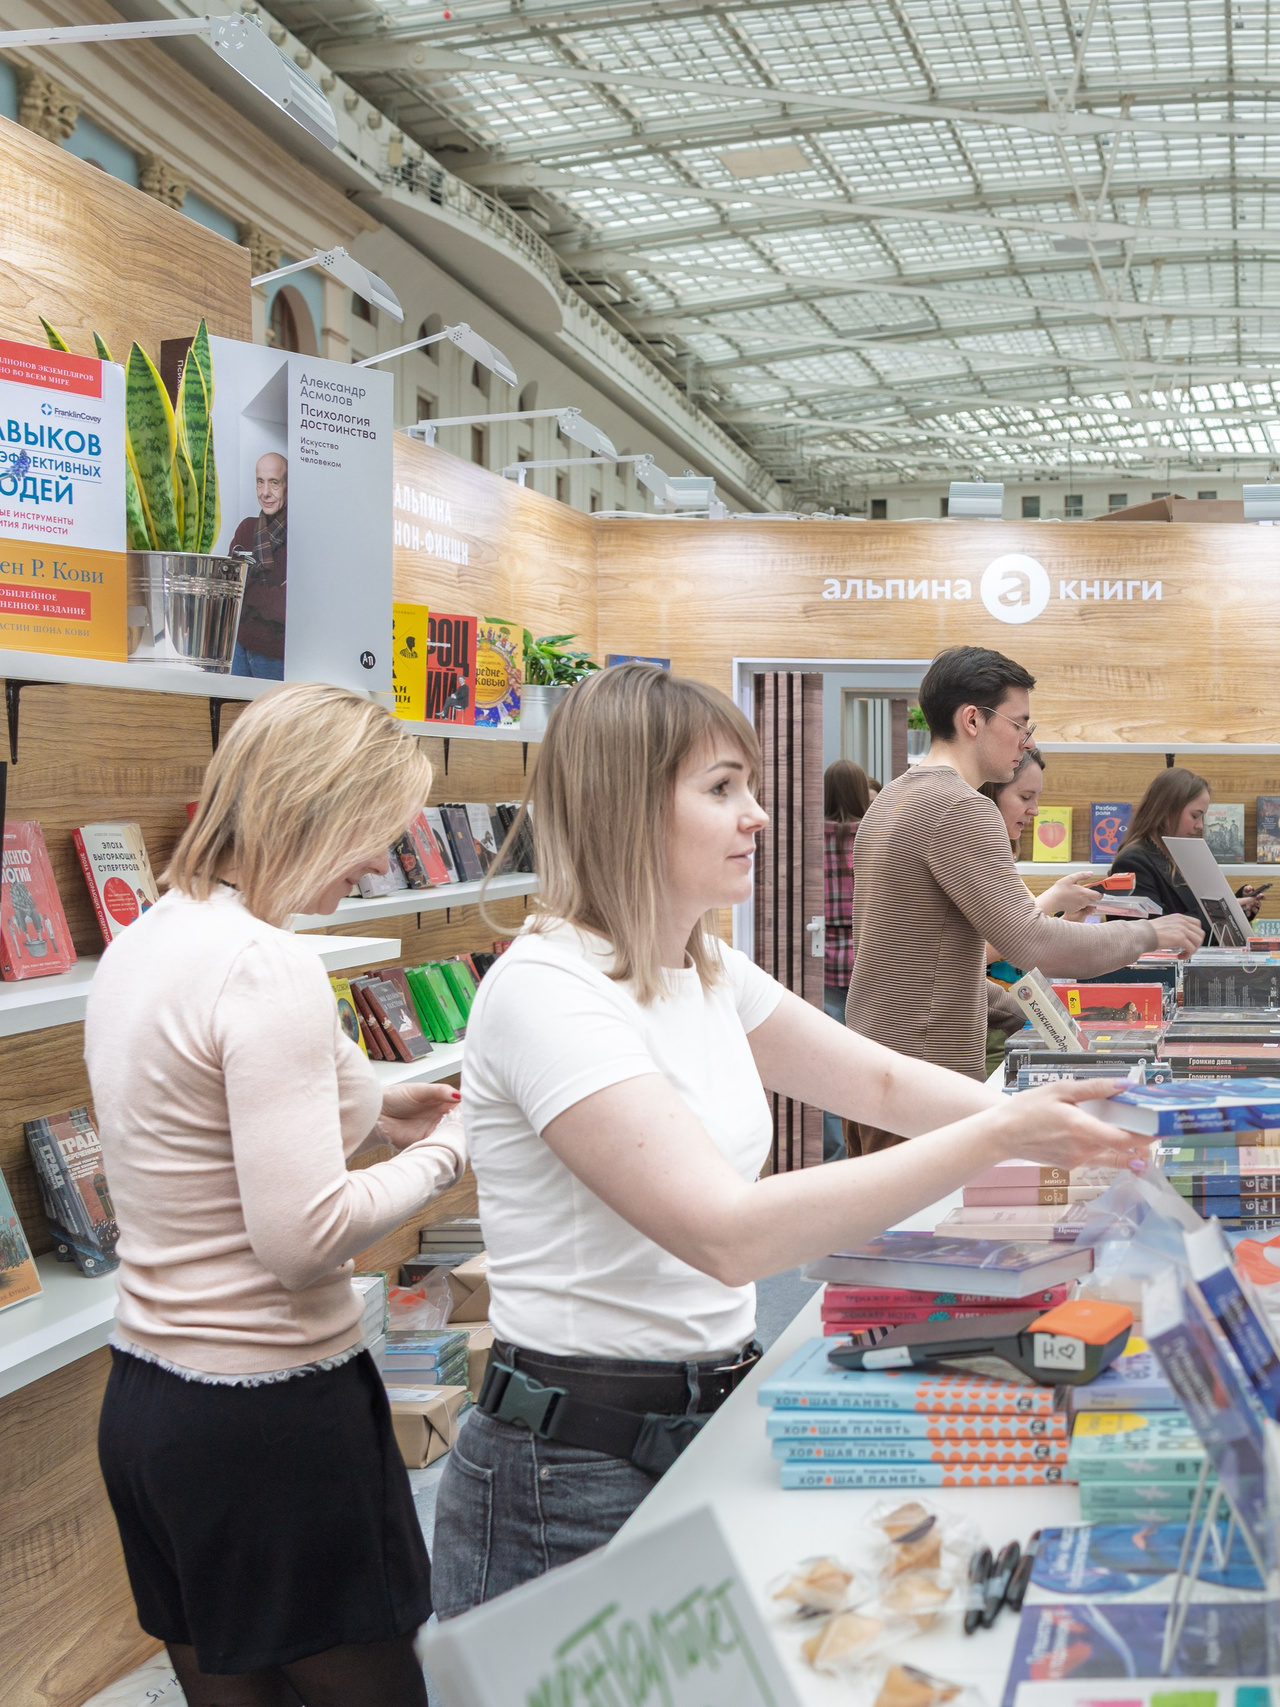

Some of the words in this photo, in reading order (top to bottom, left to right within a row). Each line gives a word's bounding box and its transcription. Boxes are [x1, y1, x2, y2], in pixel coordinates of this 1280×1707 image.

[0, 357, 37, 370] ЛИОНОВ
[38, 365, 94, 381] ЭКЗЕМПЛЯРОВ
[12, 369, 24, 377] ВО
[25, 371, 47, 381] ВСЕМ
[48, 376, 70, 386] МИРЕ
[300, 374, 366, 399] Александр
[300, 386, 353, 406] Асмолов
[54, 407, 102, 424] FranklinCovey
[301, 403, 370, 427] Психология
[300, 419, 377, 440] достоинства
[300, 437, 339, 450] Искусство
[300, 446, 319, 456] быть
[300, 457, 341, 468] человеком
[394, 482, 452, 525] АЛЬПИНА
[13, 511, 74, 526] ИНСТРУМЕНТЫ
[21, 522, 69, 535] ЛИЧНОСТИ
[394, 520, 469, 566] НОН-ФИКШН
[31, 558, 45, 578] Р.
[53, 560, 104, 584] Кови
[822, 578, 972, 601] альпина
[1059, 580, 1163, 601] книги
[42, 605, 87, 616] ИЗДАНИЕ
[33, 624, 62, 634] ШОНА
[65, 628, 90, 637] КОВИ
[101, 841, 124, 849] ЭПОХА
[92, 853, 137, 861] ВЫГОРАЮЩИХ
[97, 864, 140, 872] СУПЕРГЕРОЕВ
[80, 852, 90, 871] ЭПОХА
[86, 872, 102, 910] ВЫГОРАЮЩИХ
[1188, 1057, 1215, 1065] Громкие
[1216, 1058, 1232, 1066] дела
[1028, 1072, 1075, 1082] ГРАД
[57, 1130, 101, 1157] ГРАД
[1051, 1168, 1060, 1179] 6
[843, 1398, 899, 1408] ПАМЯТЬ
[853, 1426, 911, 1434] ПАМЯТЬ
[858, 1449, 915, 1459] ПАМЯТЬ
[869, 1475, 927, 1484] ПАМЯТЬ
